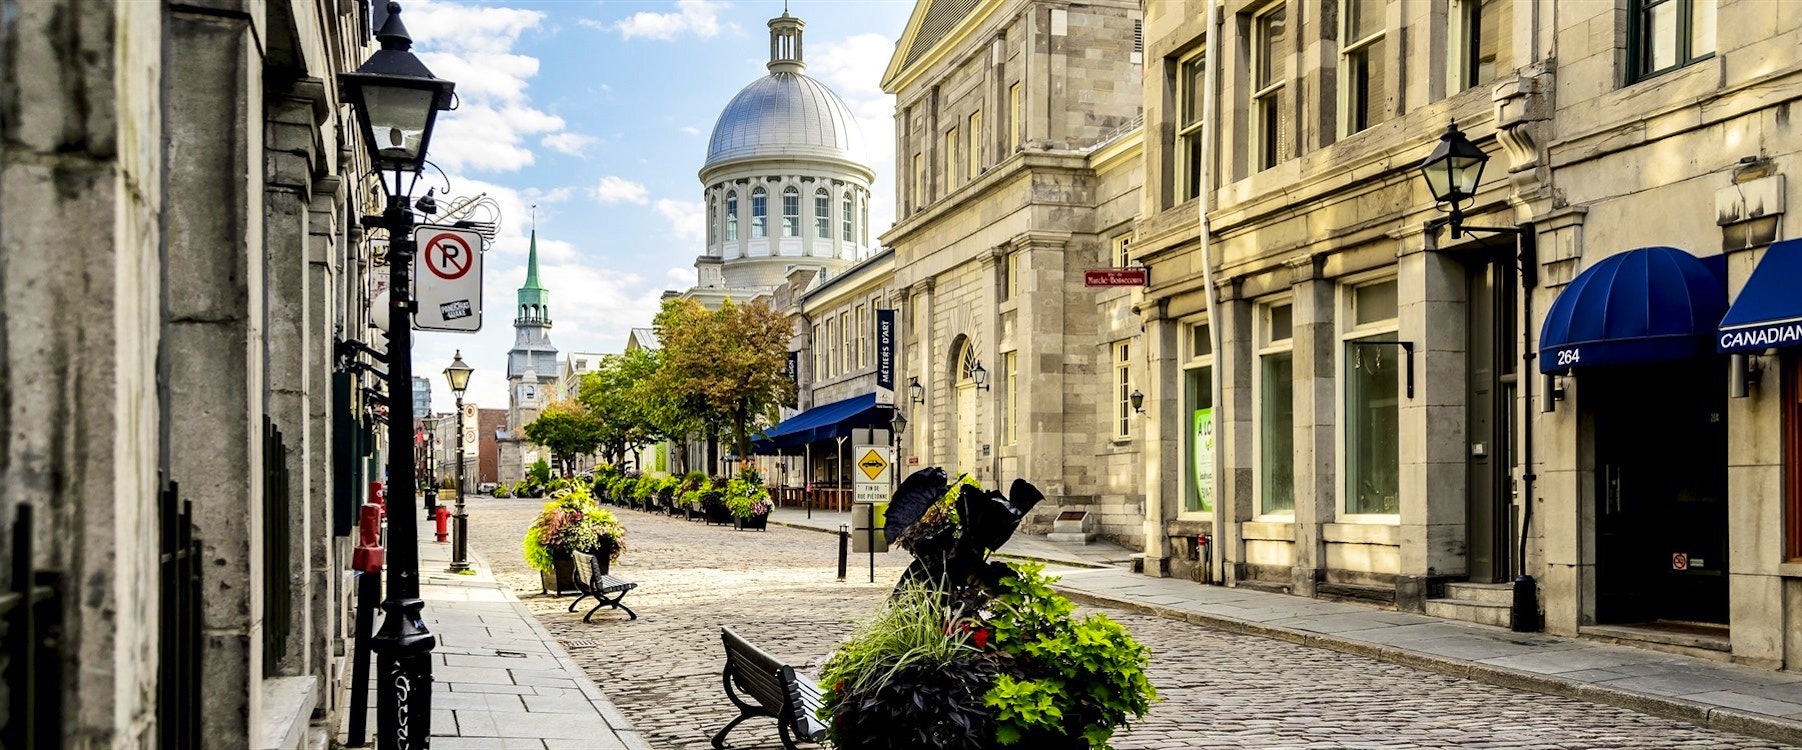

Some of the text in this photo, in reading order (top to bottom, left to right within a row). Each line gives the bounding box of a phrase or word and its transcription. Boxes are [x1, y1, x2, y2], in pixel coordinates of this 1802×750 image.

[881, 346, 889, 383] MÉTIERS
[1558, 348, 1580, 366] 264
[867, 492, 887, 500] PIÉTONNE
